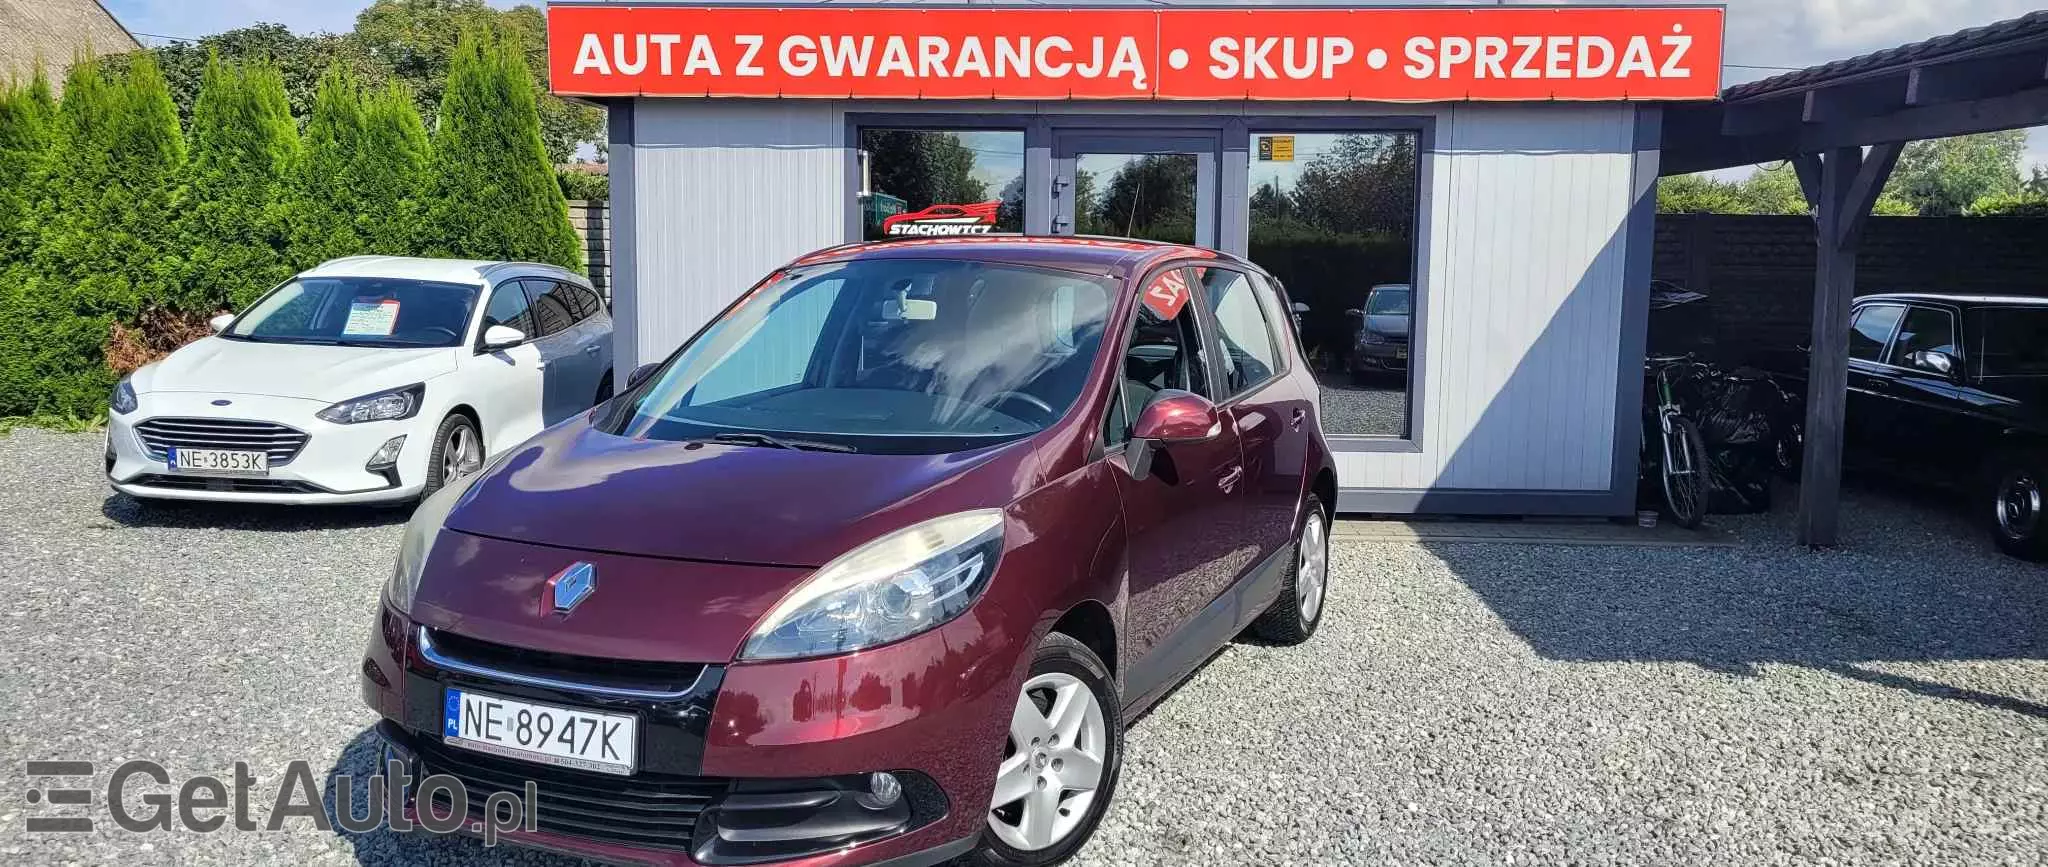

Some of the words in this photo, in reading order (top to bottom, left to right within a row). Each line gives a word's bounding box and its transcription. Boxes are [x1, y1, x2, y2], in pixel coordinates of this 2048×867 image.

[572, 33, 722, 77] AUTA
[734, 35, 765, 77] Z
[777, 35, 1148, 90] GWARANCJĄ
[1208, 36, 1355, 80] SKUP
[1403, 23, 1694, 79] SPRZEDAŻ
[180, 451, 202, 468] NE
[209, 452, 262, 470] 3853K
[447, 718, 458, 730] PL
[464, 699, 504, 741] NE
[516, 708, 622, 761] 8947K
